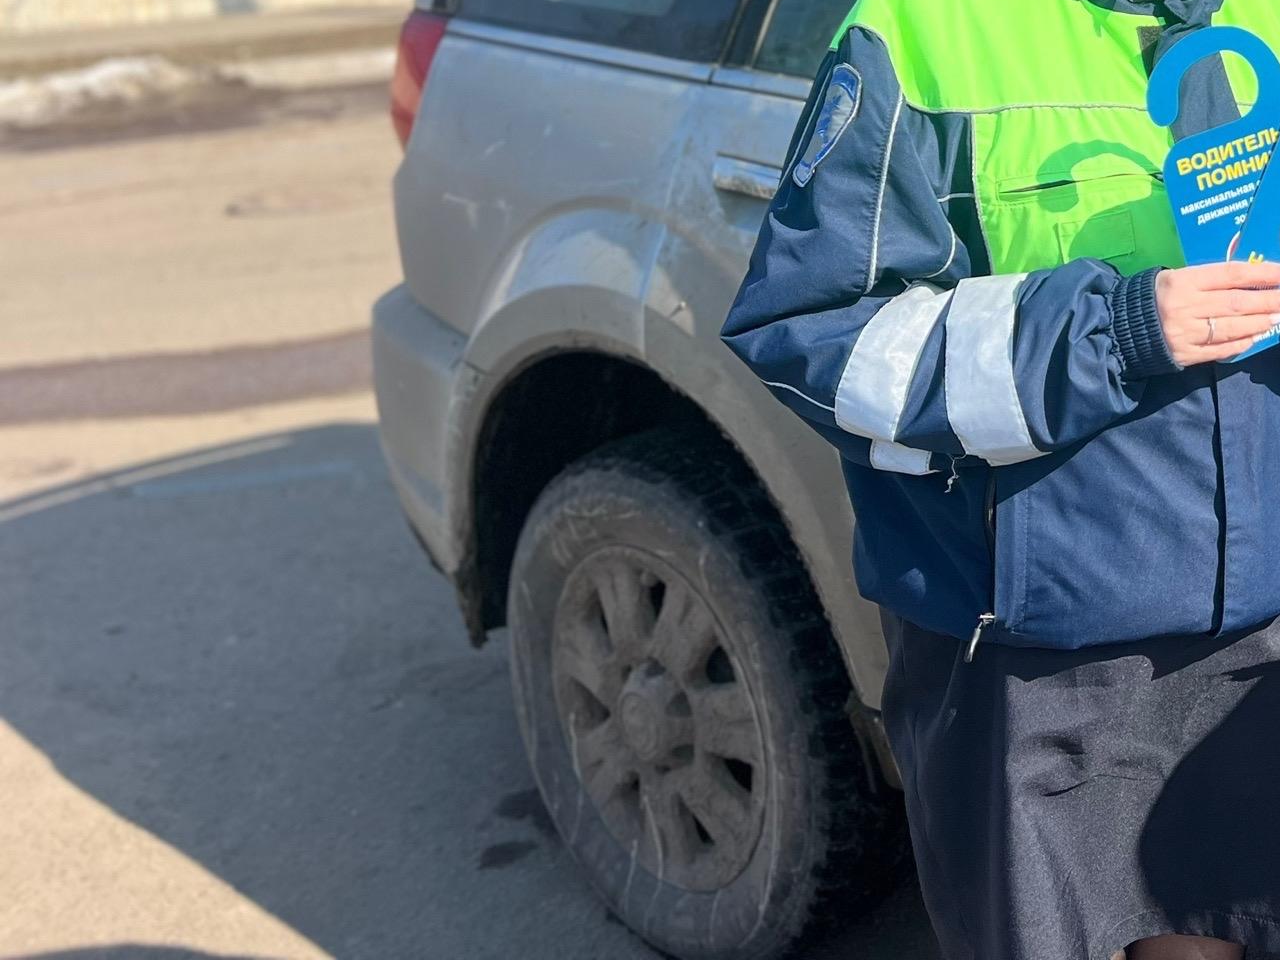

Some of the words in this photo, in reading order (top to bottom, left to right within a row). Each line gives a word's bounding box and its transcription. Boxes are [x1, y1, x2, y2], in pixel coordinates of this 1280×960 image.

[1196, 150, 1271, 191] ПОМНИ
[1180, 182, 1255, 215] максимальная
[1197, 199, 1249, 226] движения
